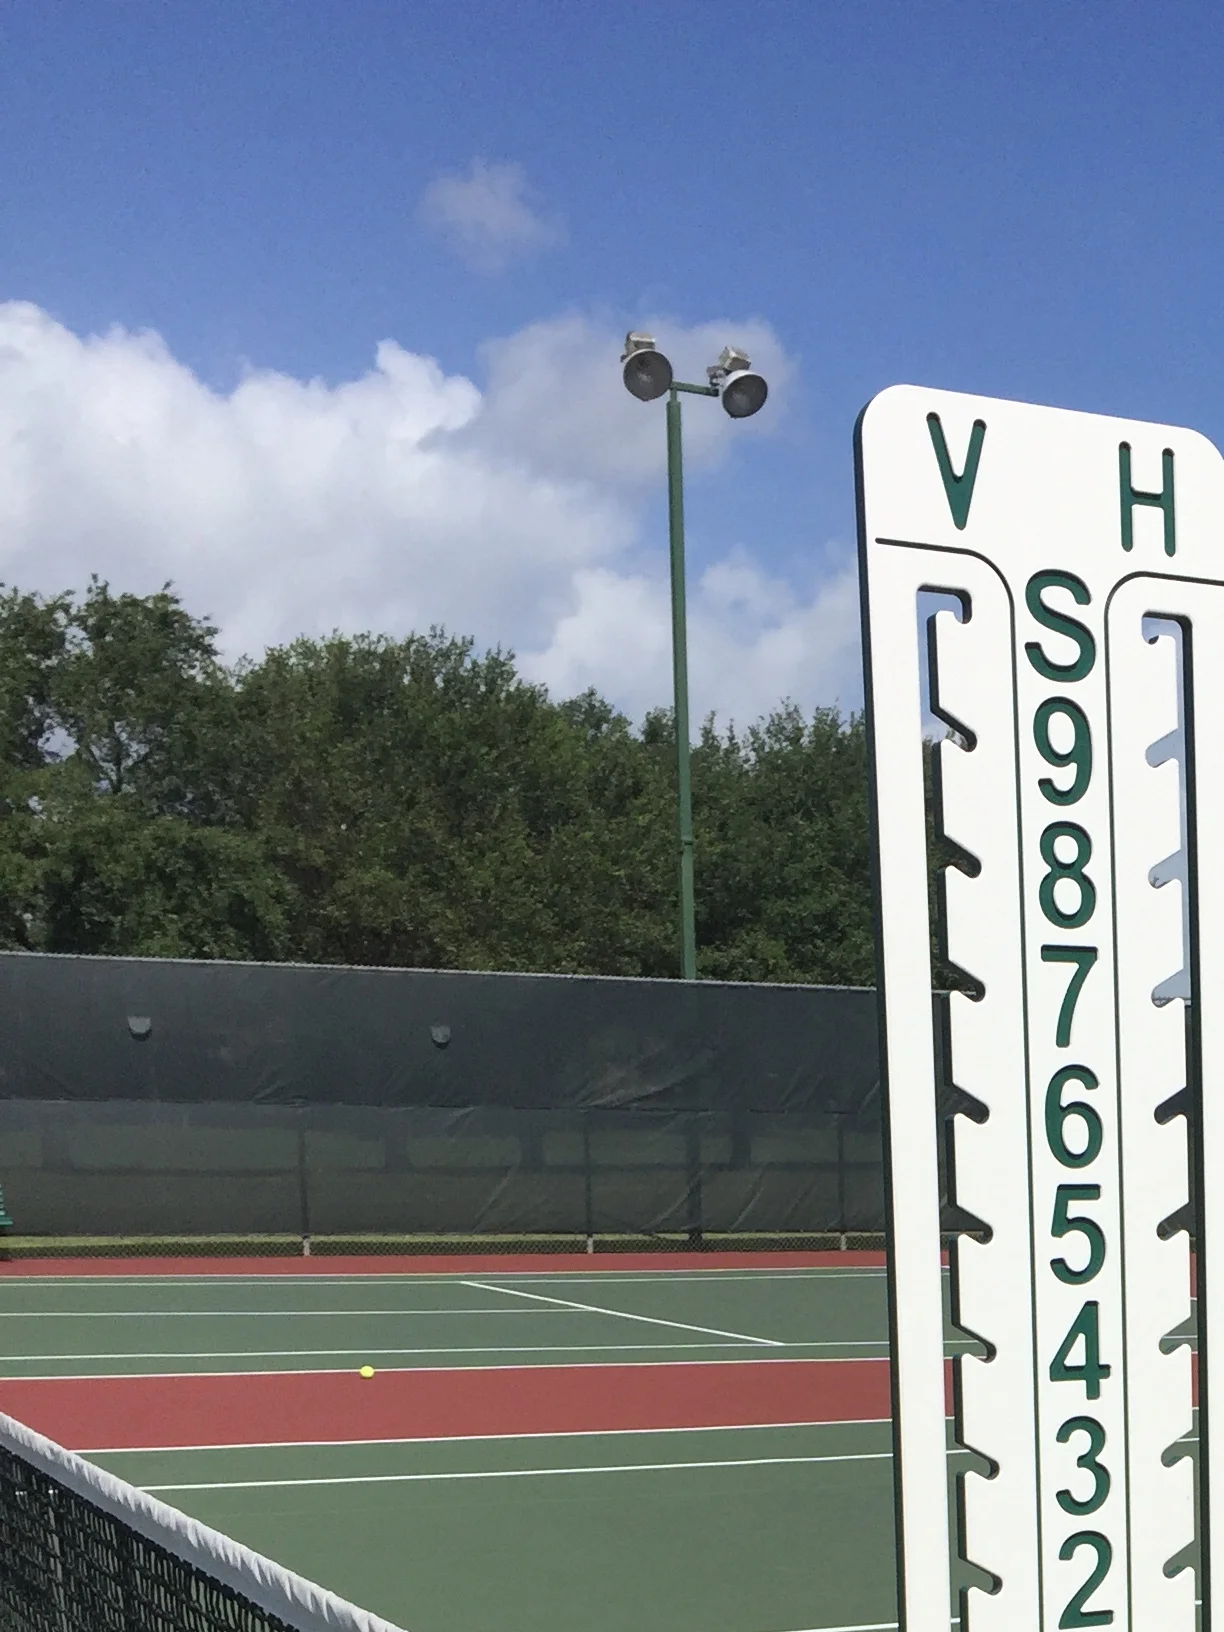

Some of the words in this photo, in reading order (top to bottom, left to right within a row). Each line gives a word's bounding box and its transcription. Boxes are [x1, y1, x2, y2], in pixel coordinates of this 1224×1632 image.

[926, 411, 987, 530] V
[1119, 440, 1176, 557] H
[1024, 569, 1096, 682] S
[1033, 696, 1092, 806] 9
[1039, 821, 1096, 929] 8
[1041, 944, 1098, 1049] 7
[1045, 1064, 1103, 1169] 6
[1049, 1183, 1107, 1285] 5
[1048, 1301, 1112, 1400] 4
[1056, 1416, 1111, 1516] 3
[1059, 1530, 1115, 1630] 2
